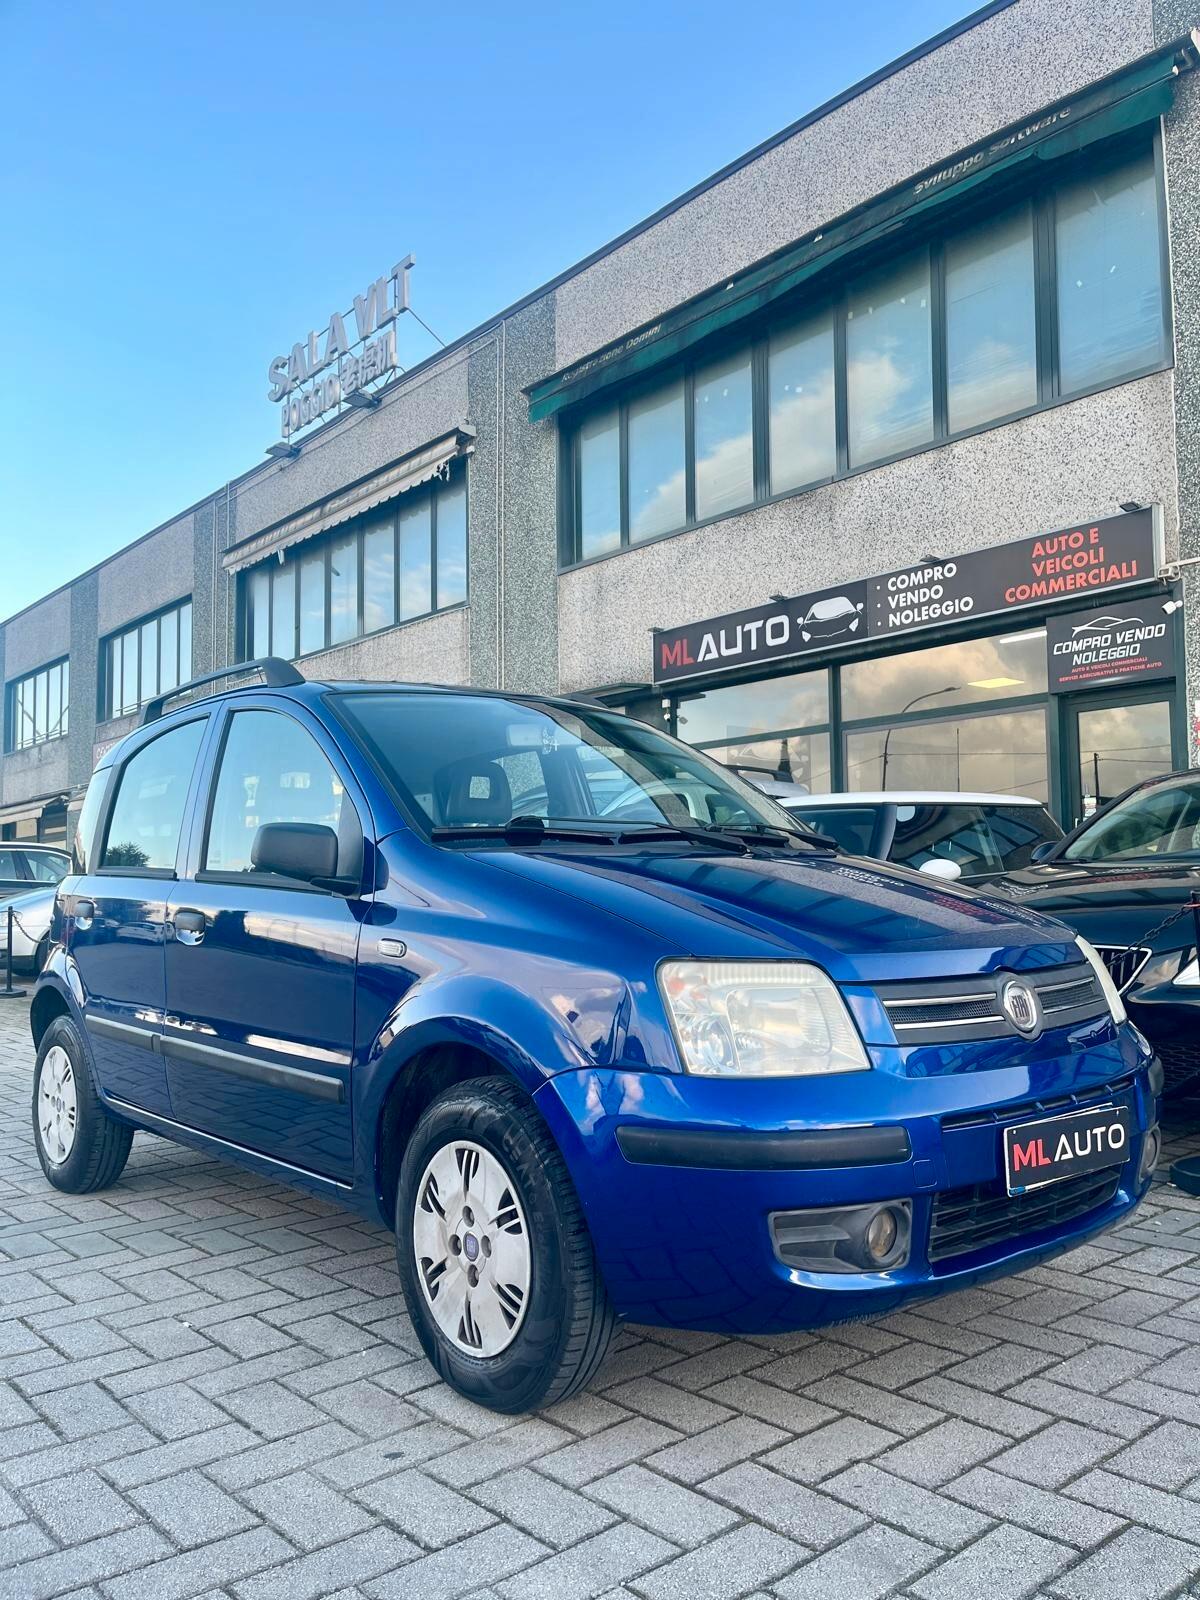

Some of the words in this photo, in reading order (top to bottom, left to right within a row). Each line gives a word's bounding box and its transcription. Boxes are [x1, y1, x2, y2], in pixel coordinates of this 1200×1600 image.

[913, 151, 985, 194] Sviluppo
[268, 312, 349, 402] SALA
[353, 253, 416, 341] VLT
[281, 373, 341, 438] POGGIO
[1031, 531, 1084, 558] AUTO
[1089, 527, 1099, 544] E
[887, 562, 957, 592] COMPRO
[1032, 547, 1104, 577] VEICOLI
[1004, 560, 1137, 603] COMMERCIALI
[887, 585, 944, 610] VENDO
[888, 596, 974, 628] NOLEGGIO
[1053, 634, 1112, 655] COMPRO
[1116, 624, 1166, 643] VENDO
[1072, 643, 1141, 666] NOLEGGIO
[1111, 657, 1148, 667] COMMERCIALI
[1119, 664, 1146, 673] PRATICHE
